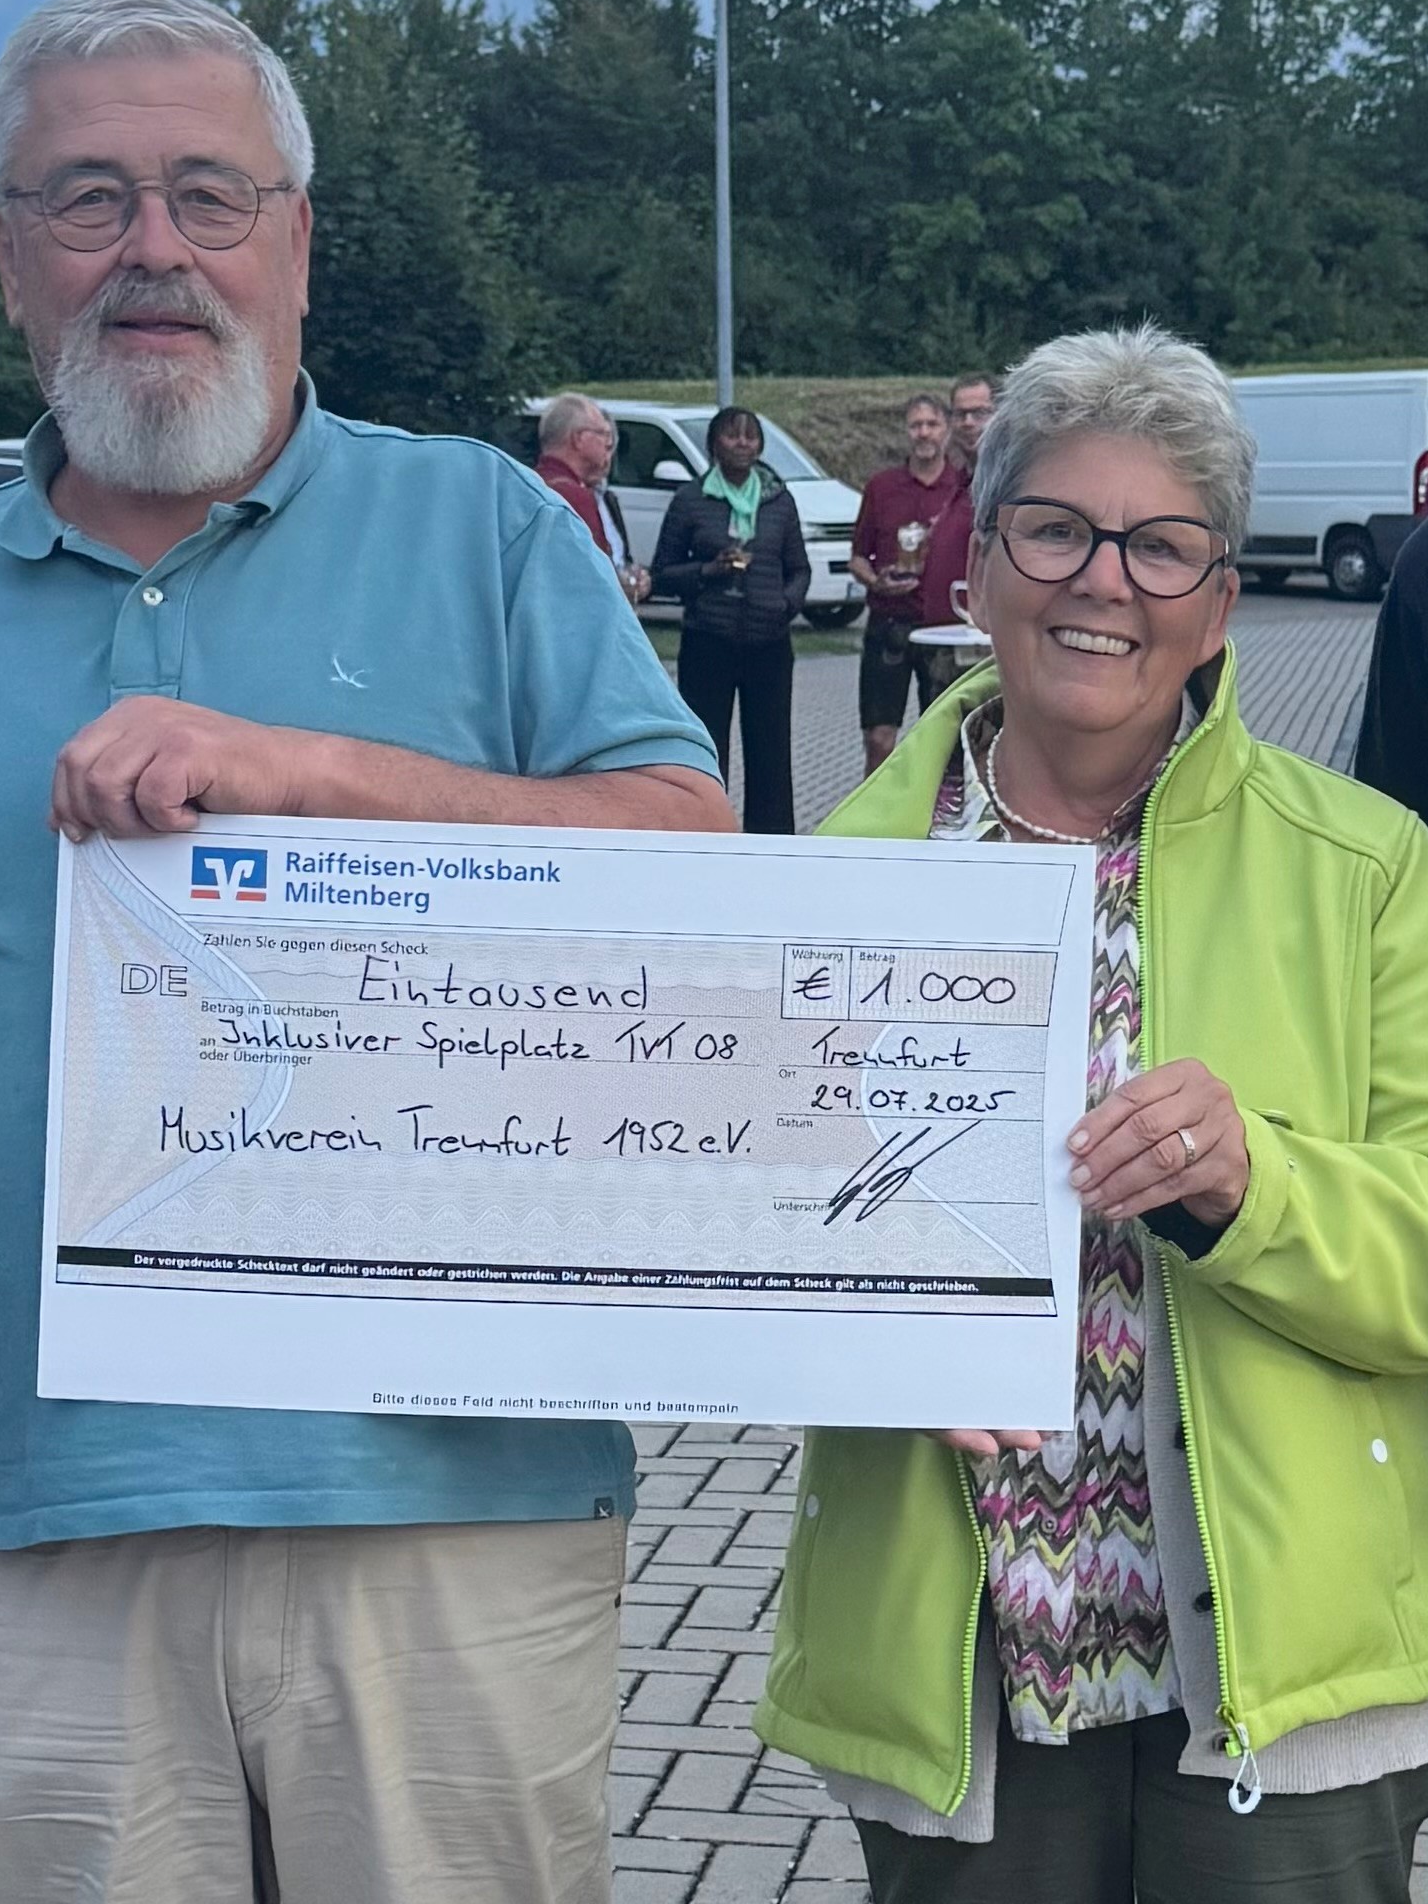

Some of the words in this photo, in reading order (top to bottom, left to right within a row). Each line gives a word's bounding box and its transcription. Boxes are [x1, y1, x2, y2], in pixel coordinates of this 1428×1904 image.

[286, 852, 561, 883] Raiffeisen-Volksbank
[285, 882, 431, 913] Miltenberg
[203, 933, 251, 947] Zahlen
[280, 939, 325, 953] gegen
[330, 937, 377, 953] diesen
[381, 940, 429, 955] Scheck
[120, 963, 188, 997] DE
[359, 955, 647, 1010] Eintausend
[792, 967, 833, 1001] €
[860, 967, 1016, 1006] 1.000
[201, 1001, 244, 1016] Betrag
[248, 1003, 260, 1015] in
[264, 1004, 339, 1018] Buchstaben
[199, 1037, 216, 1047] an
[199, 1050, 229, 1062] oder
[233, 1050, 312, 1066] Überbringer
[218, 1019, 402, 1051] Inklusiver
[416, 1021, 590, 1070] Spielplatz
[694, 1033, 739, 1061] 08
[161, 1105, 381, 1153] Musikverein
[397, 1104, 571, 1157] Trennfurt
[603, 1117, 688, 1157] 1952
[134, 1254, 154, 1266] Der
[158, 1256, 234, 1270] vorgedruckte
[237, 1259, 298, 1273] Schecktext
[302, 1261, 325, 1274] darf
[330, 1263, 358, 1275] nicht
[362, 1264, 413, 1278] geändert
[417, 1267, 444, 1278] oder
[447, 1268, 507, 1282] gestrichen
[511, 1270, 557, 1281] werden.
[561, 1271, 581, 1282] Die
[583, 1271, 629, 1285] Angabe
[632, 1273, 661, 1284] einer
[664, 1273, 740, 1288] Zahlungsfrist
[742, 1276, 762, 1287] auf
[765, 1276, 790, 1288] dem
[794, 1277, 832, 1289] Scheck
[877, 1279, 906, 1291] nicht
